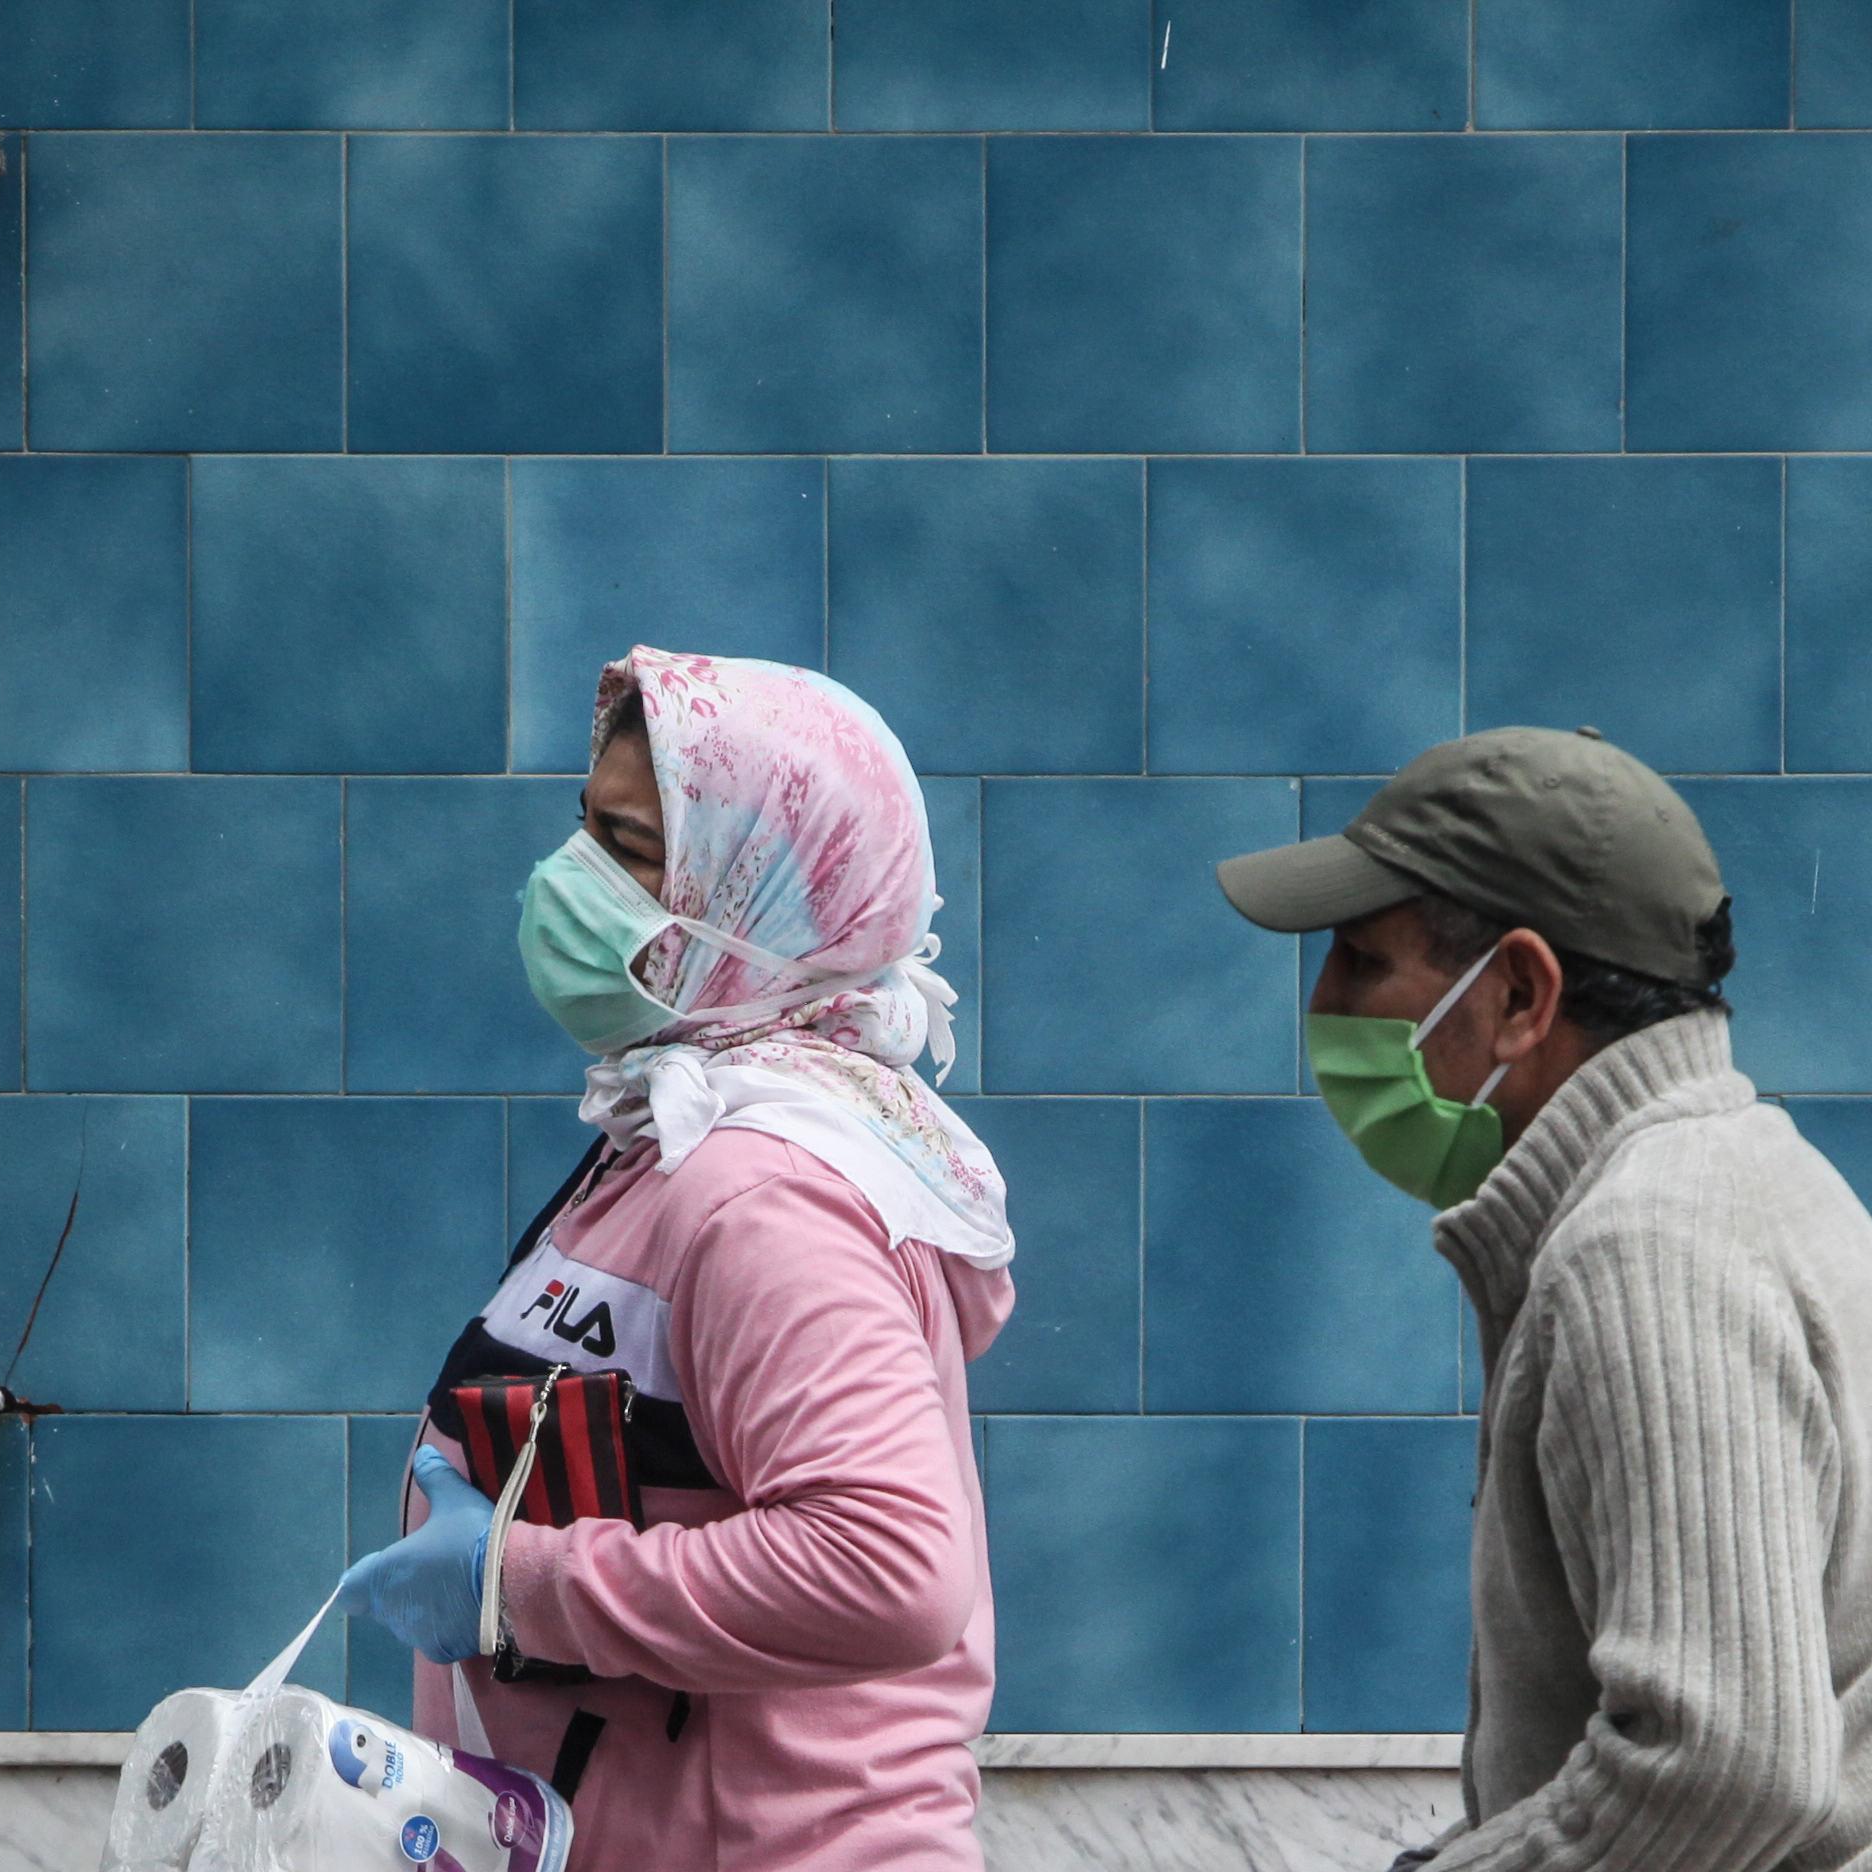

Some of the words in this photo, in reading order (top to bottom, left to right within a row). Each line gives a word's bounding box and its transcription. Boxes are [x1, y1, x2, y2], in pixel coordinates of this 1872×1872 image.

[519, 1278, 617, 1359] FILA
[382, 1740, 397, 1789] DOBLE
[414, 1835, 426, 1856] 100
